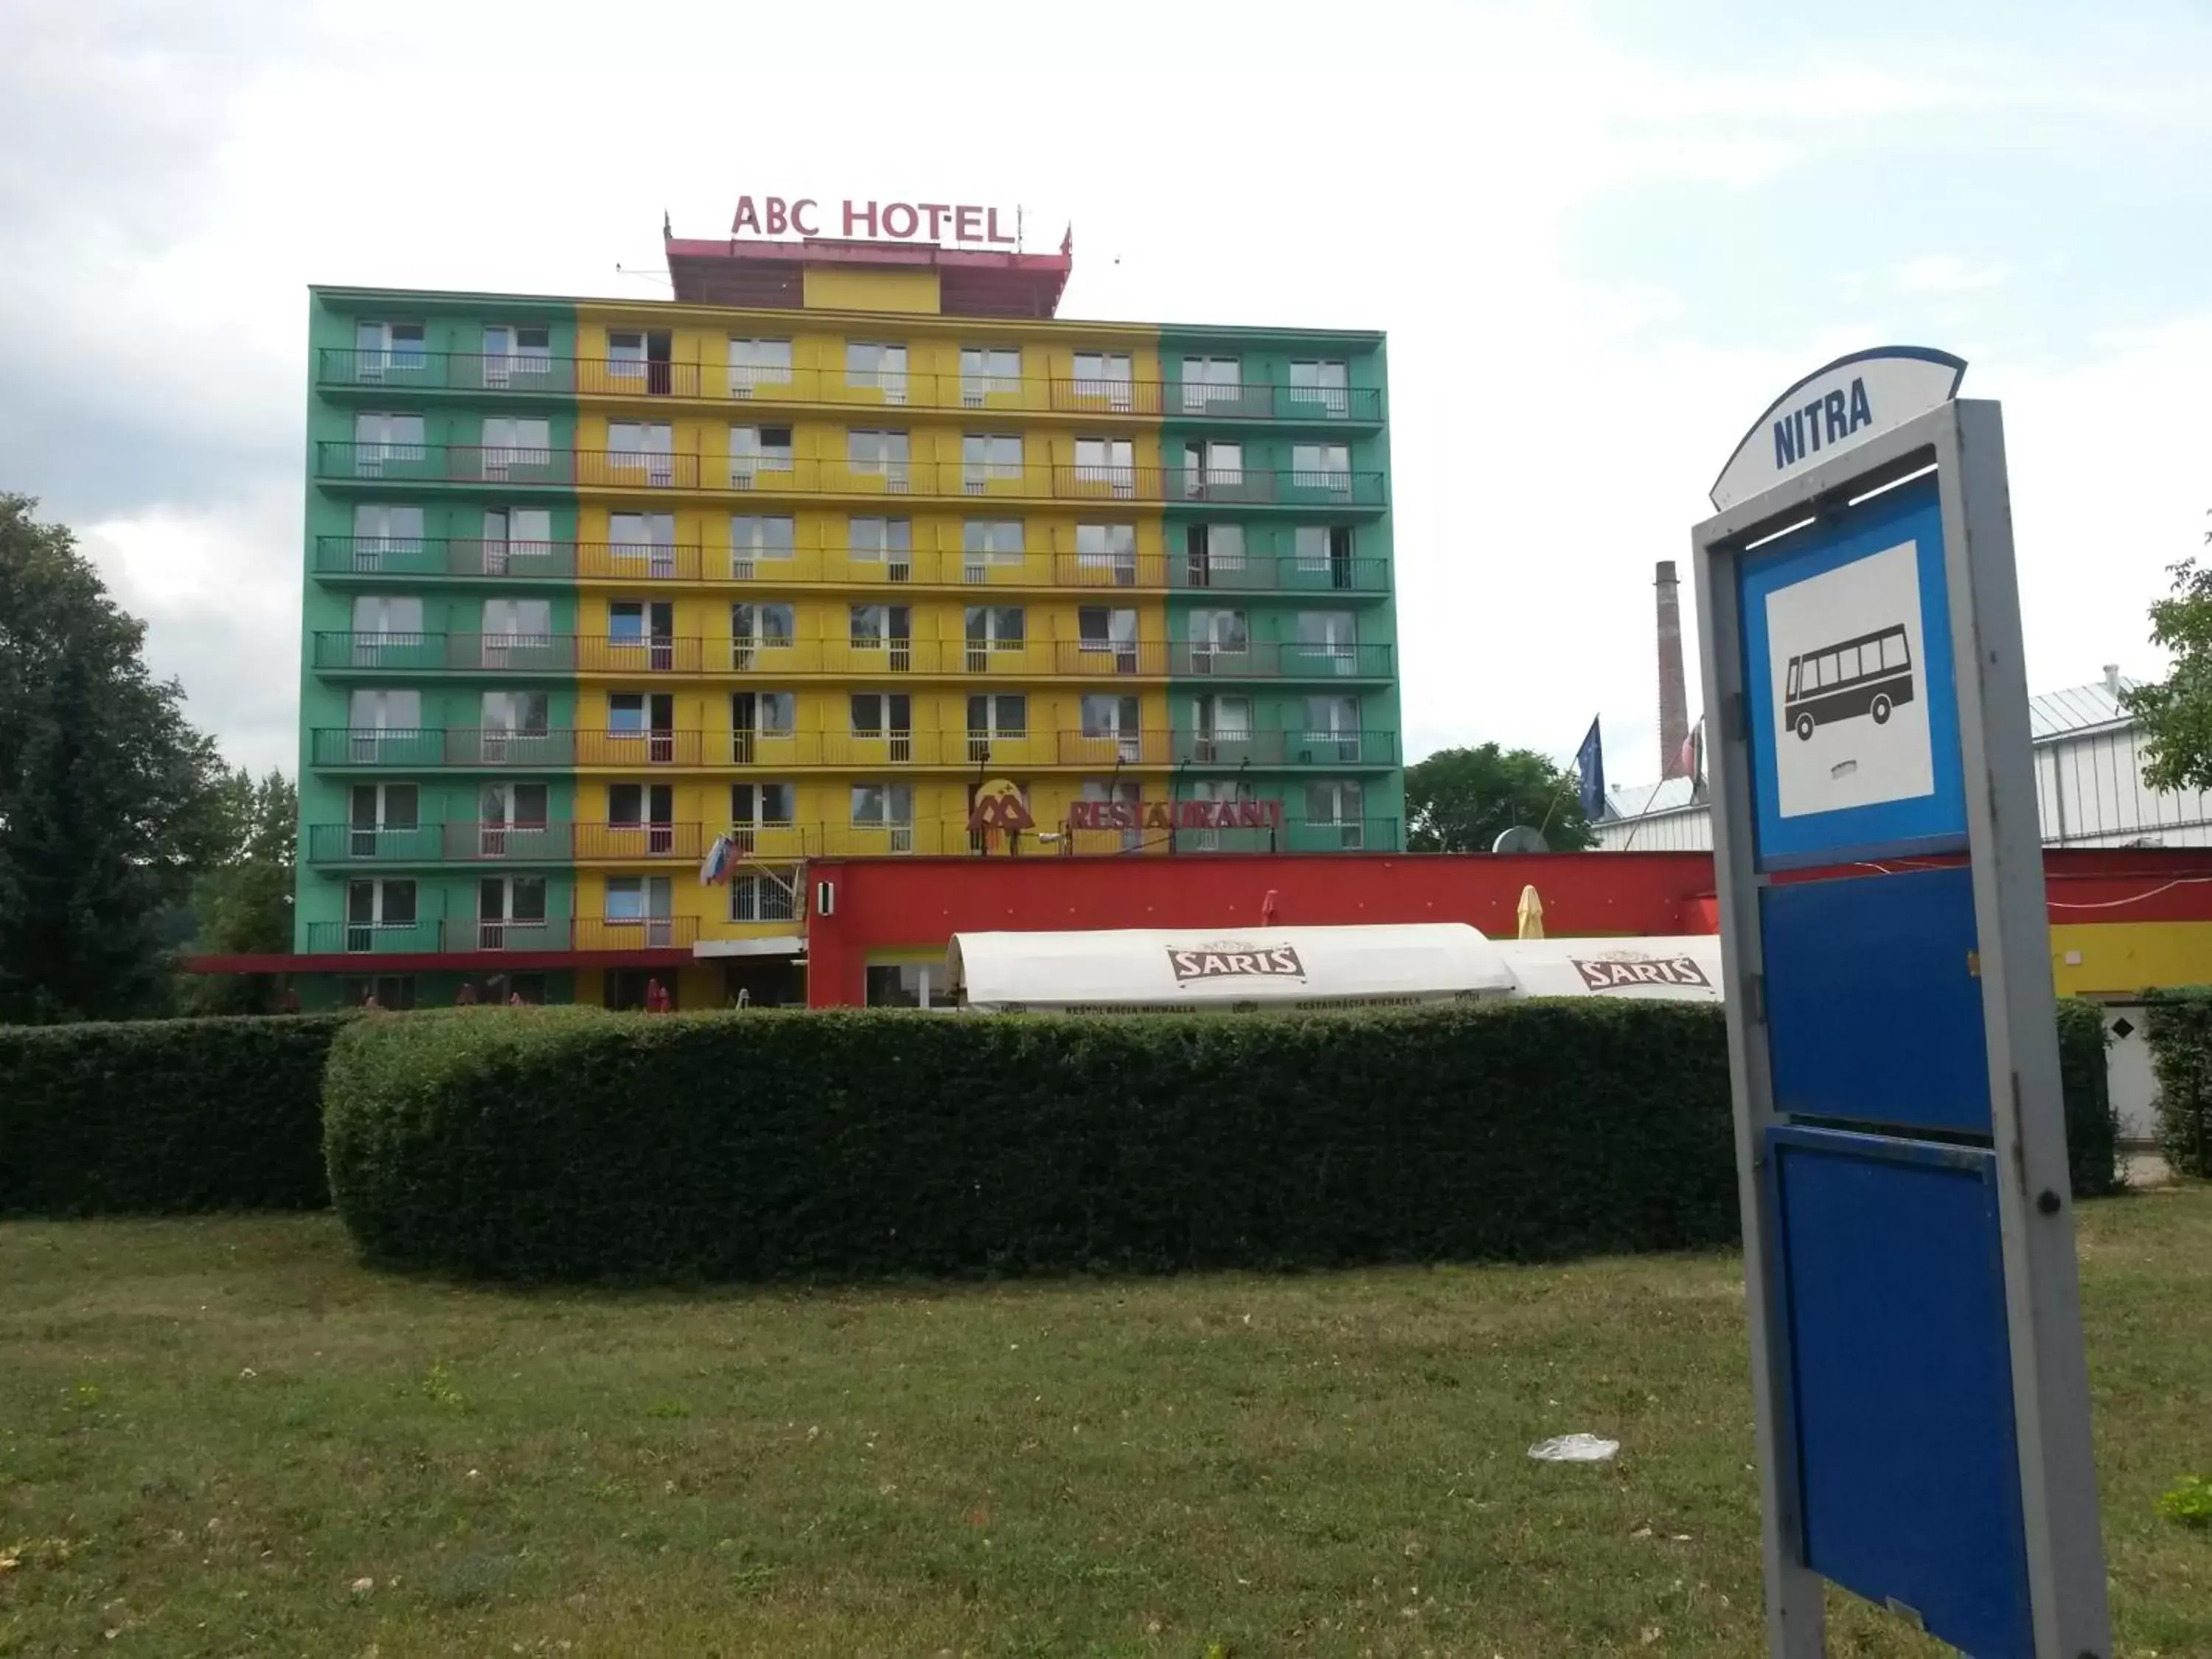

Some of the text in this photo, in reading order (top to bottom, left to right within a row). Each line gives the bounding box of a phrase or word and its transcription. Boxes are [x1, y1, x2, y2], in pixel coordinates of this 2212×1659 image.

[731, 195, 1015, 243] ABC HOTEL
[1773, 377, 1872, 470] NITRA
[1071, 800, 1282, 830] RESTAURANT
